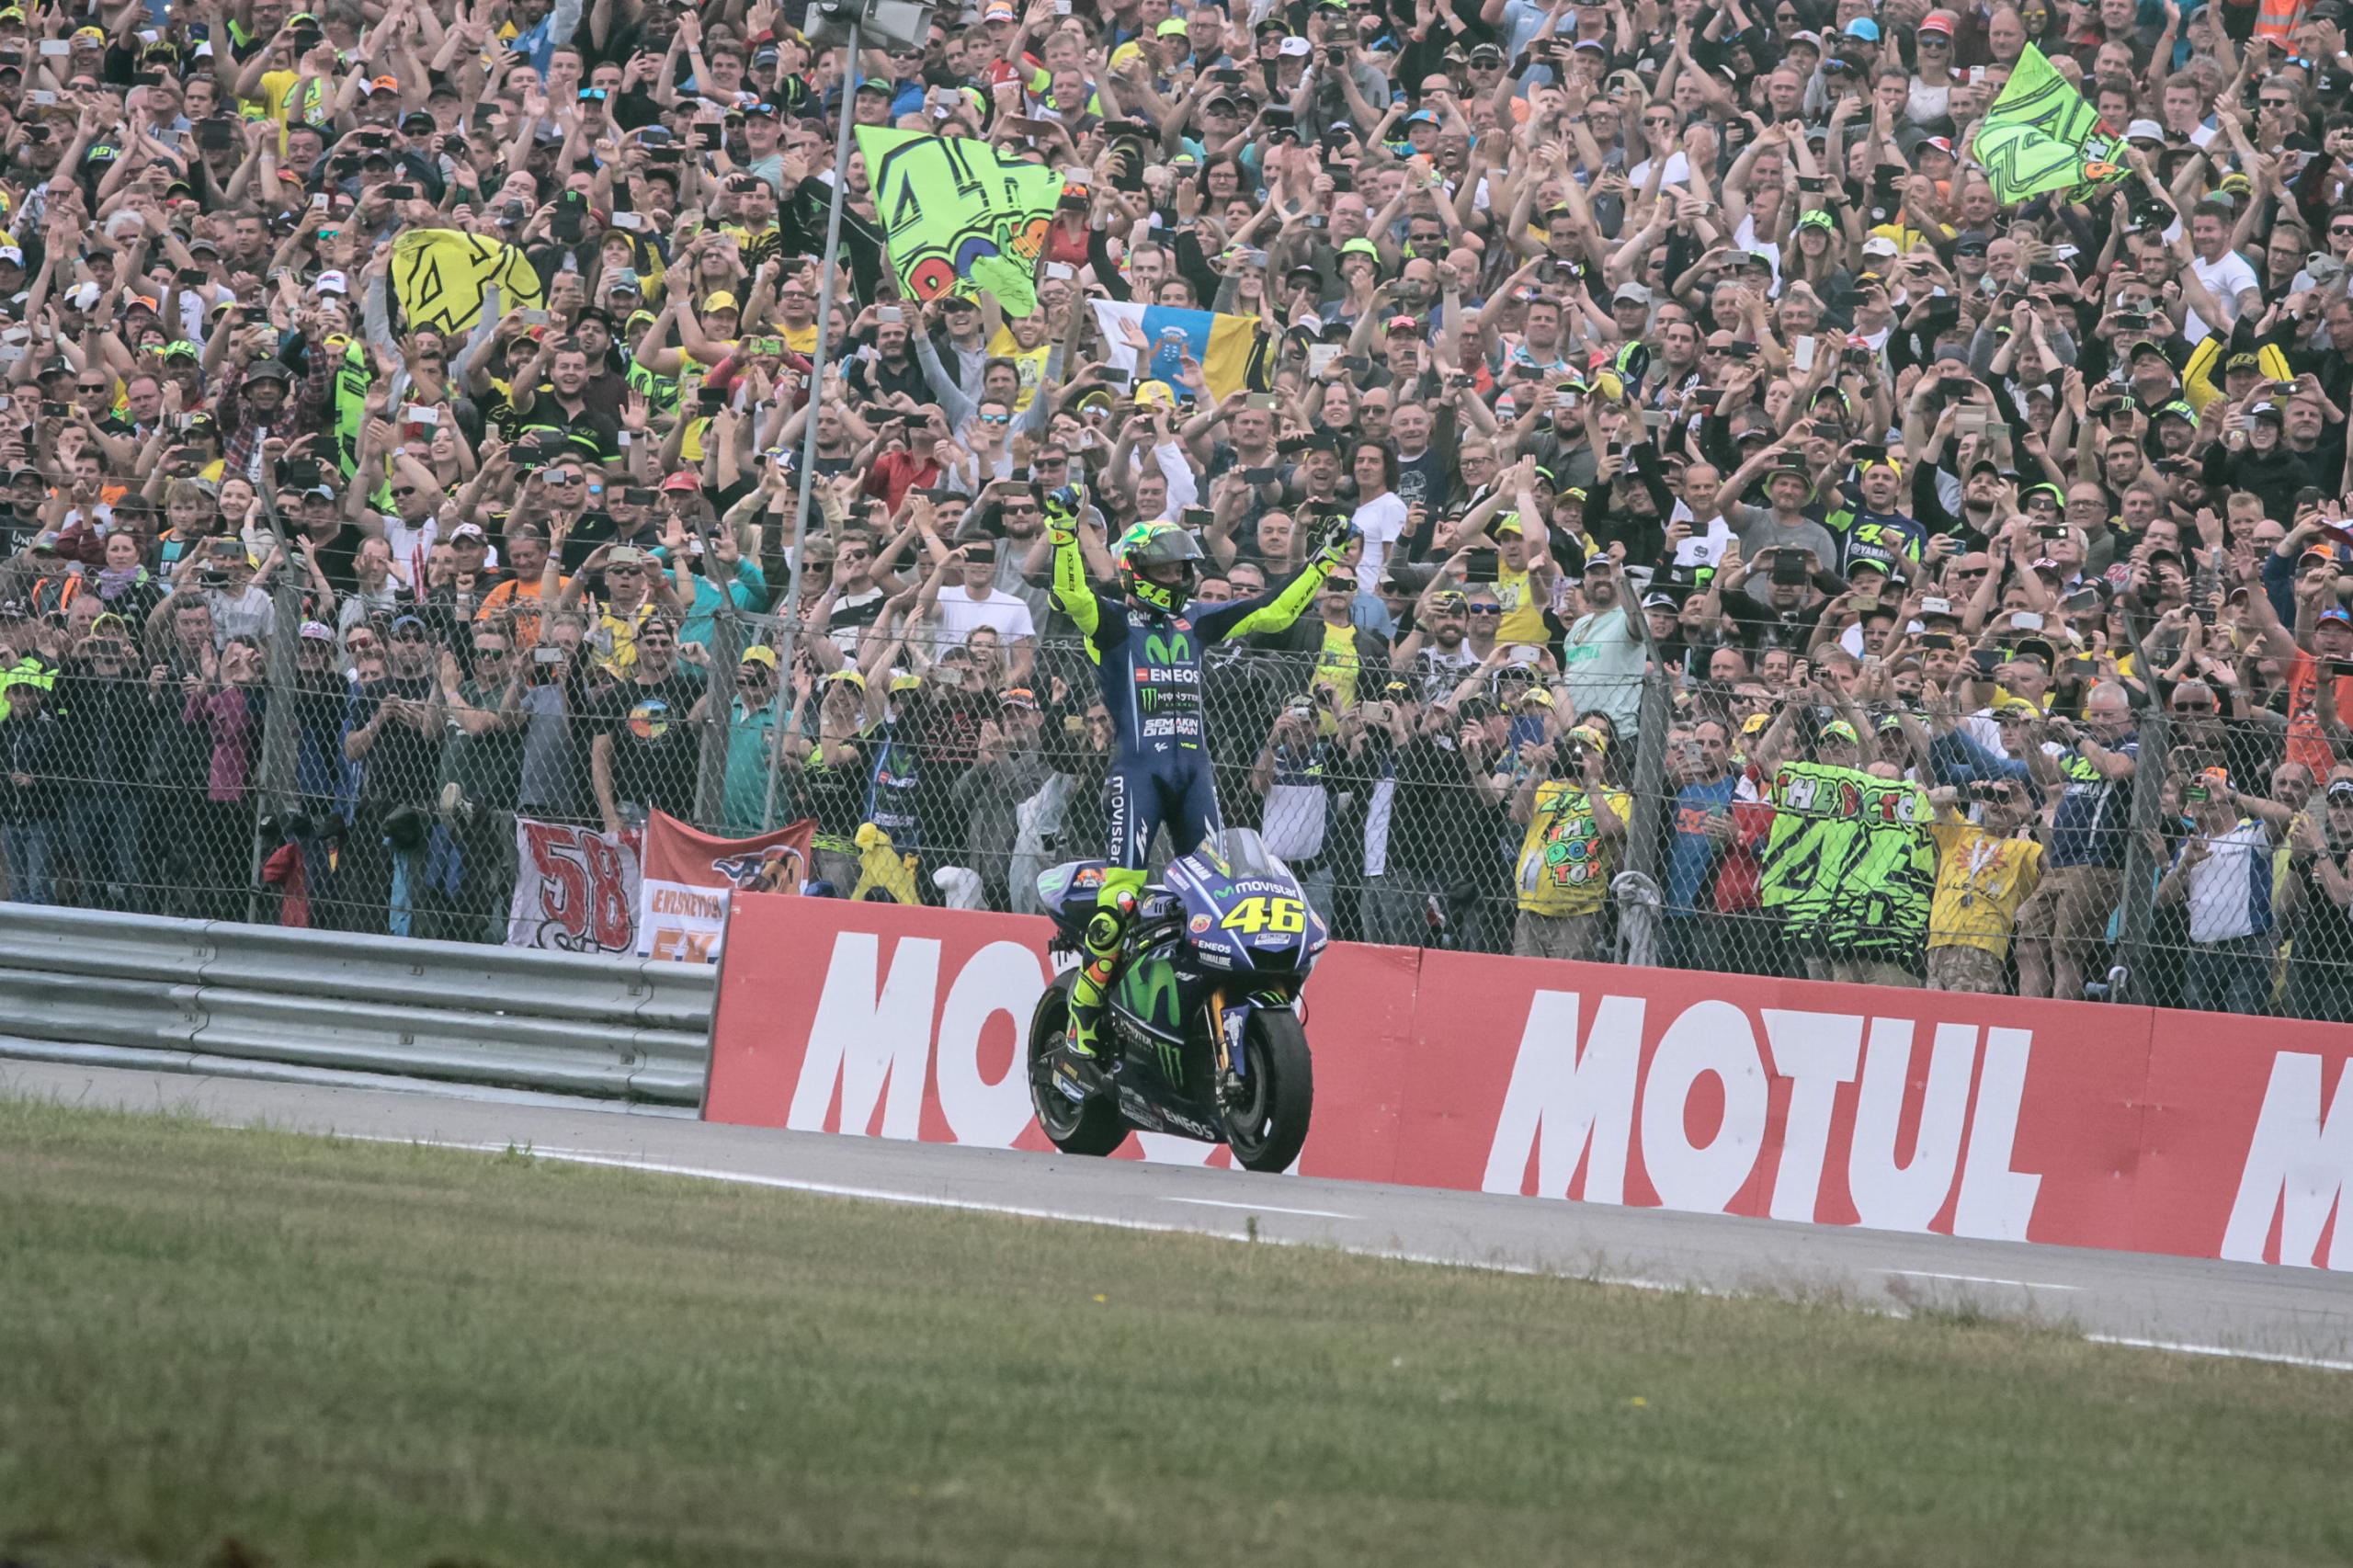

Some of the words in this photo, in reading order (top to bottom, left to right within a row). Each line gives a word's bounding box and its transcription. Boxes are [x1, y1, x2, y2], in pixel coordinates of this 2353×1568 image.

[1150, 668, 1199, 684] ENEOS
[1109, 775, 1124, 865] movistar
[522, 822, 633, 953] 58
[1235, 881, 1298, 898] movistar
[1220, 896, 1306, 934] 46
[1198, 940, 1232, 953] ENEOS
[1161, 1107, 1215, 1141] ENEOS
[1482, 989, 2042, 1243] MOTUL
